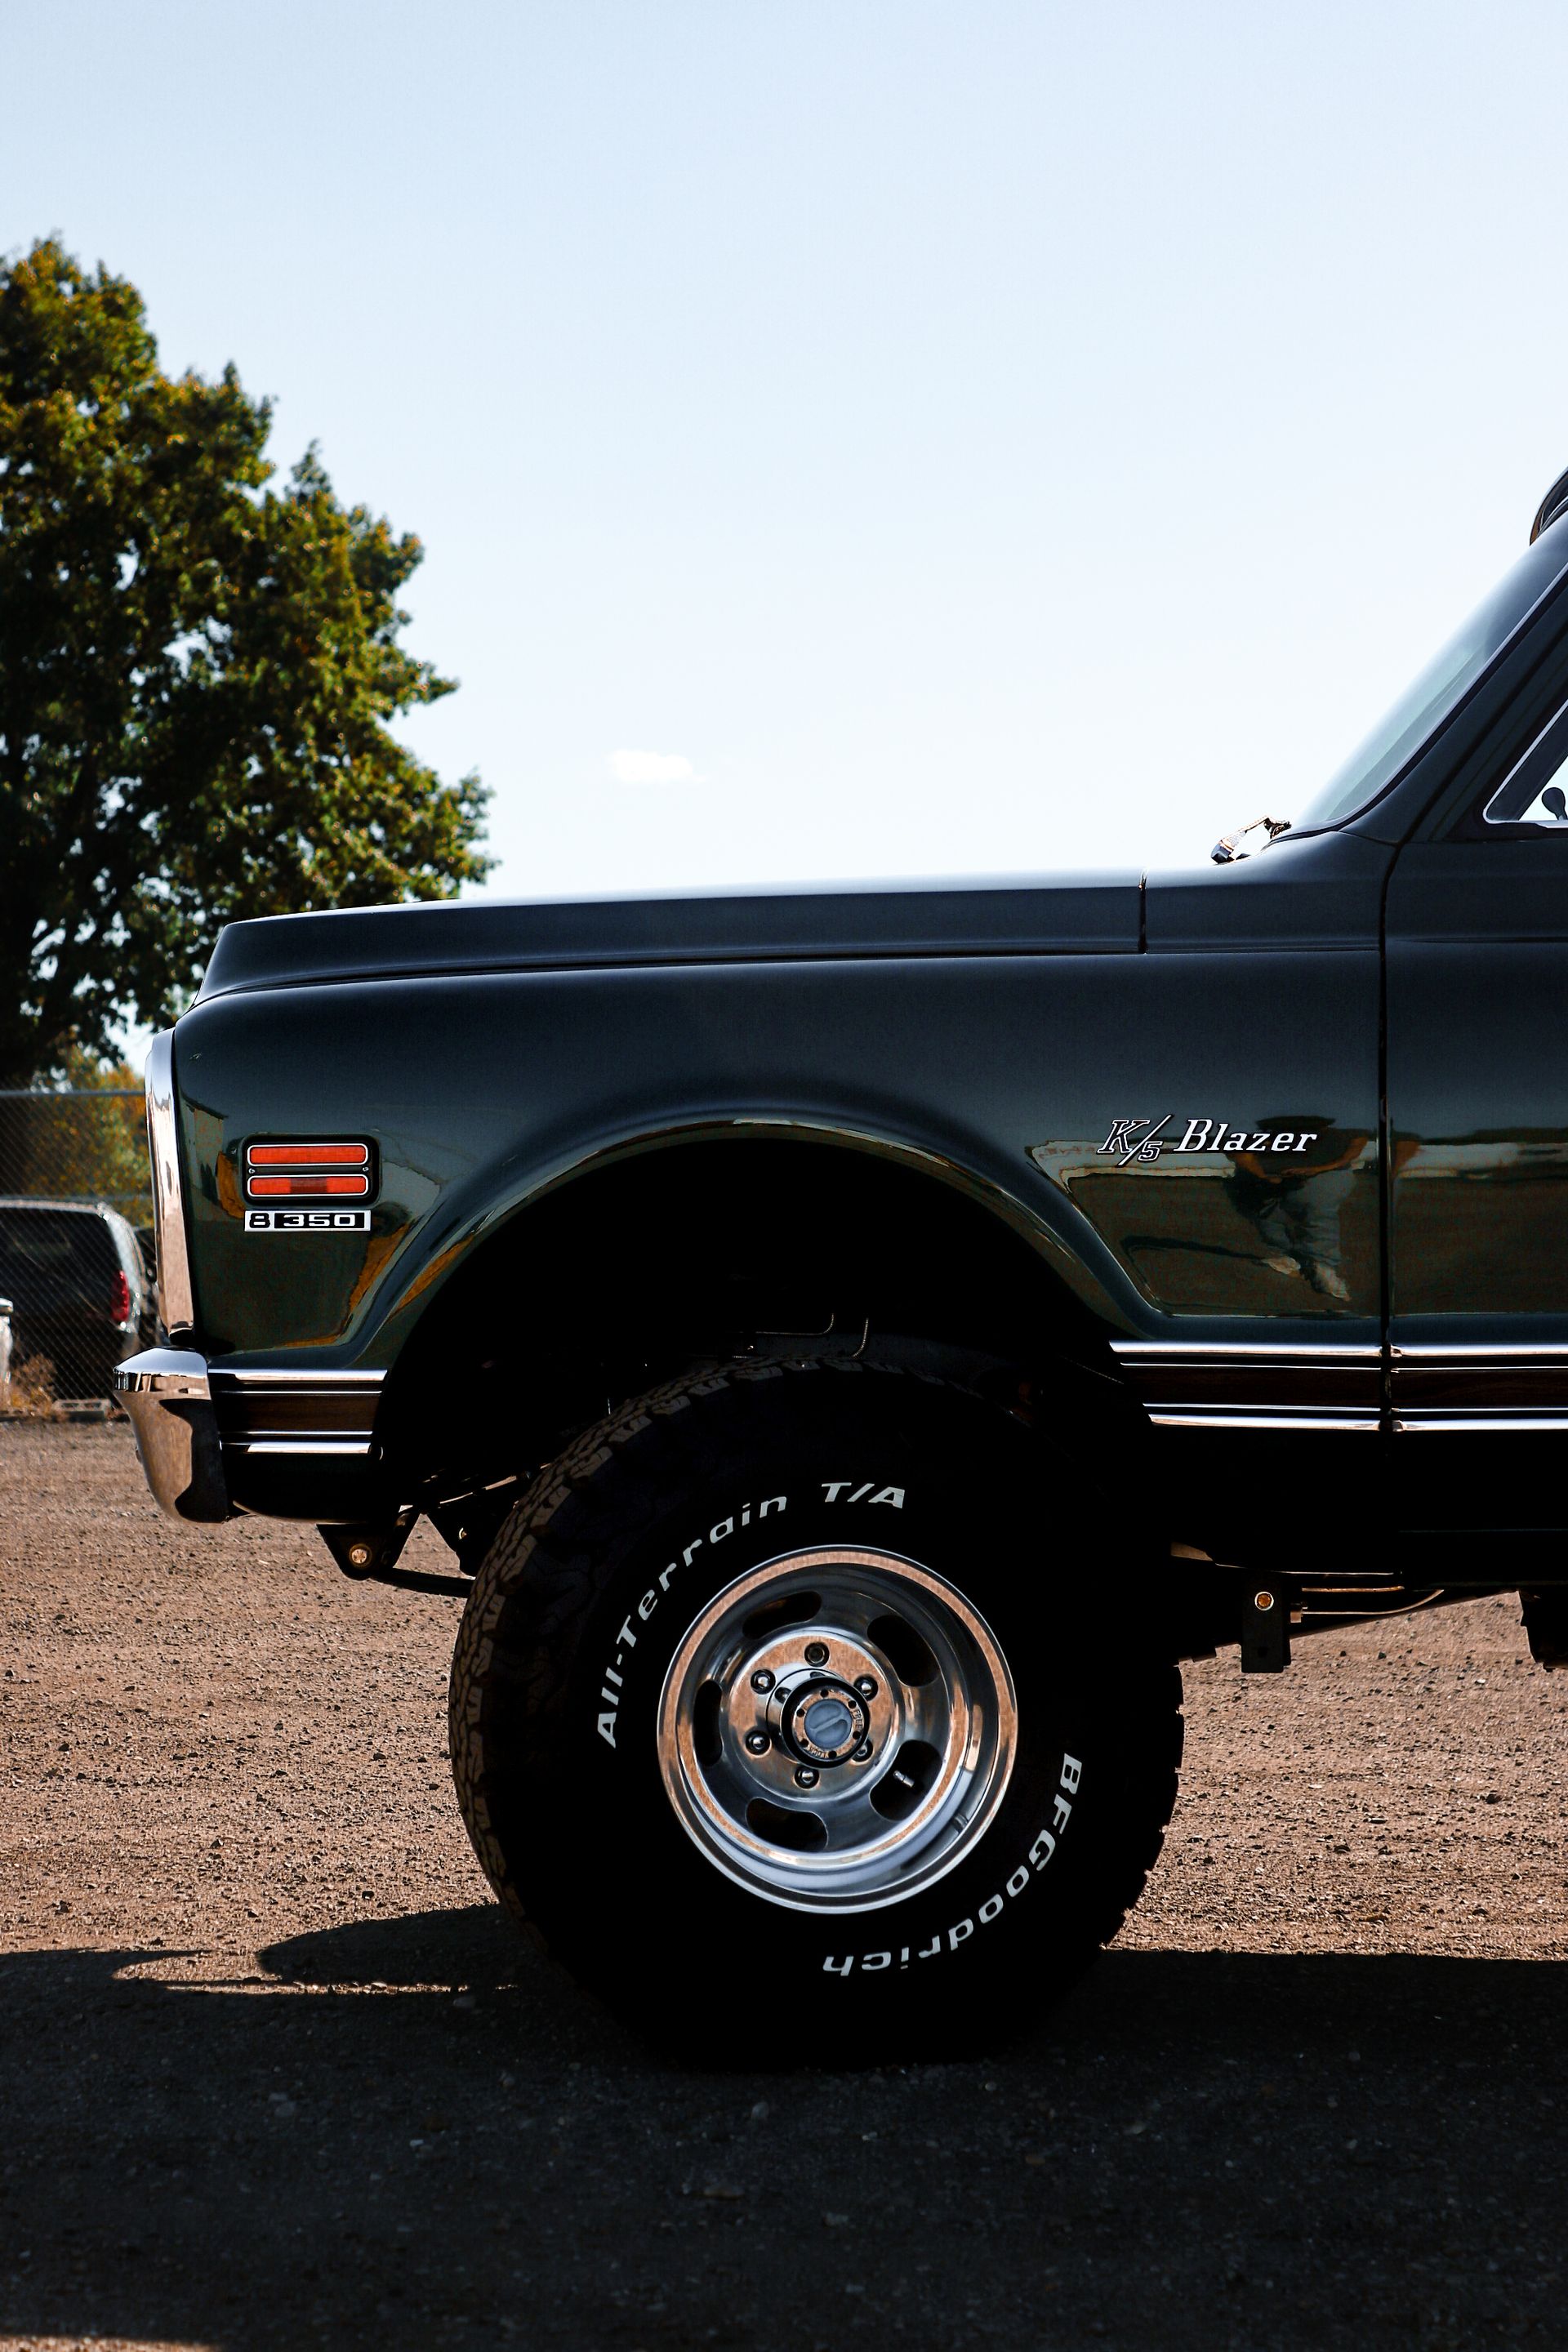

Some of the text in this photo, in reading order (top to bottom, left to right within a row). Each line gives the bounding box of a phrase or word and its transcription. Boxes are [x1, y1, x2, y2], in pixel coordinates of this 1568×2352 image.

[1174, 1118, 1318, 1152] Blazer
[249, 1213, 356, 1229] 8 350
[598, 1482, 906, 1748] All-Terrain T/A
[823, 1753, 1083, 1976] BFGoodrich
